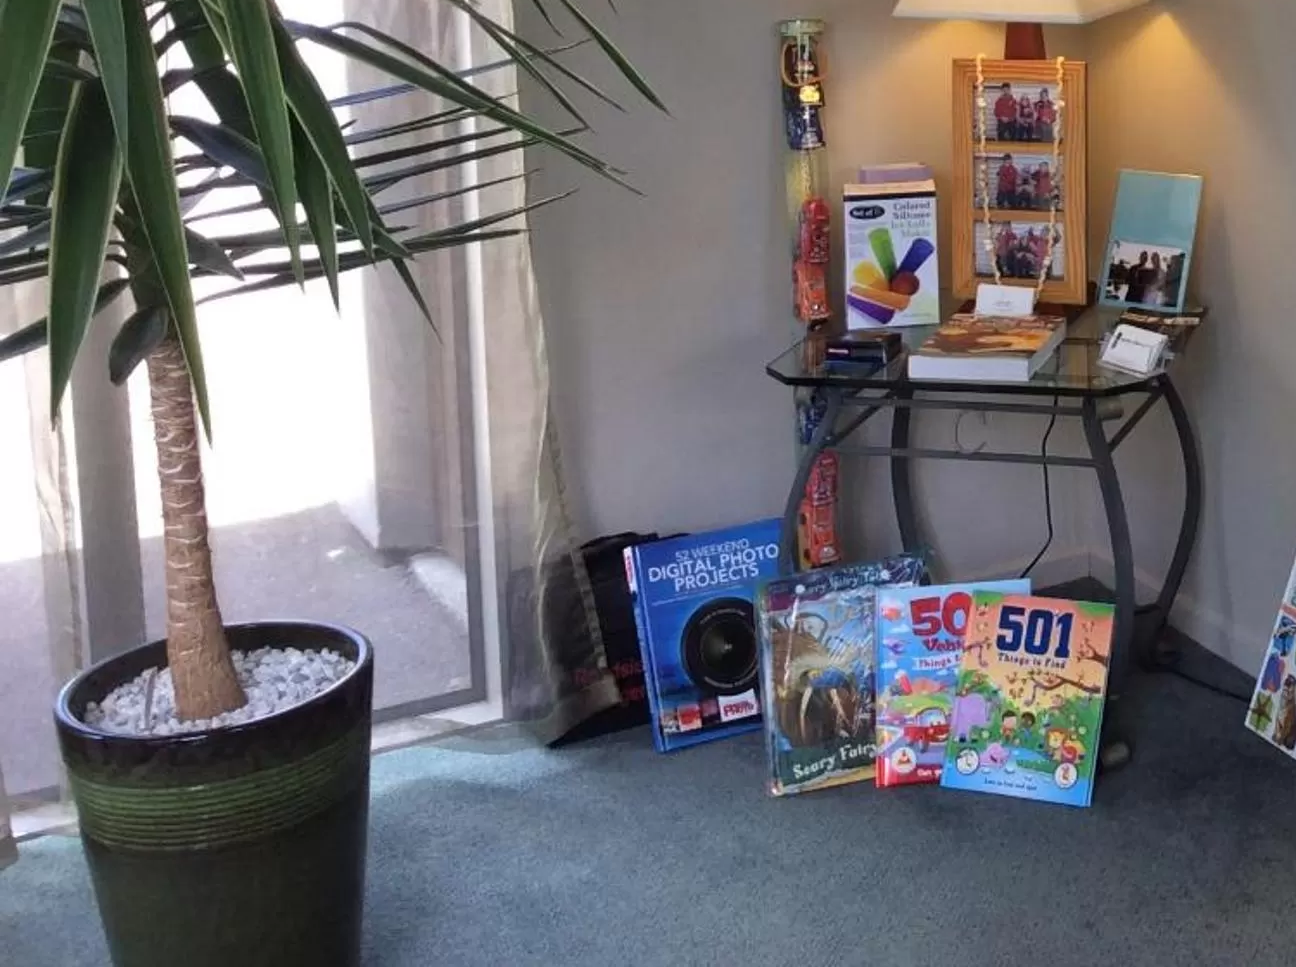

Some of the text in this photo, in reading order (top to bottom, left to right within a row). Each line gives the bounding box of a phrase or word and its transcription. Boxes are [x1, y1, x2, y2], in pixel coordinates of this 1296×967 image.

[647, 543, 780, 583] DIGITAL PHOTO
[690, 538, 750, 559] WEEKEND
[674, 562, 760, 592] PROJECTS
[910, 591, 973, 637] 50
[995, 604, 1074, 659] 501
